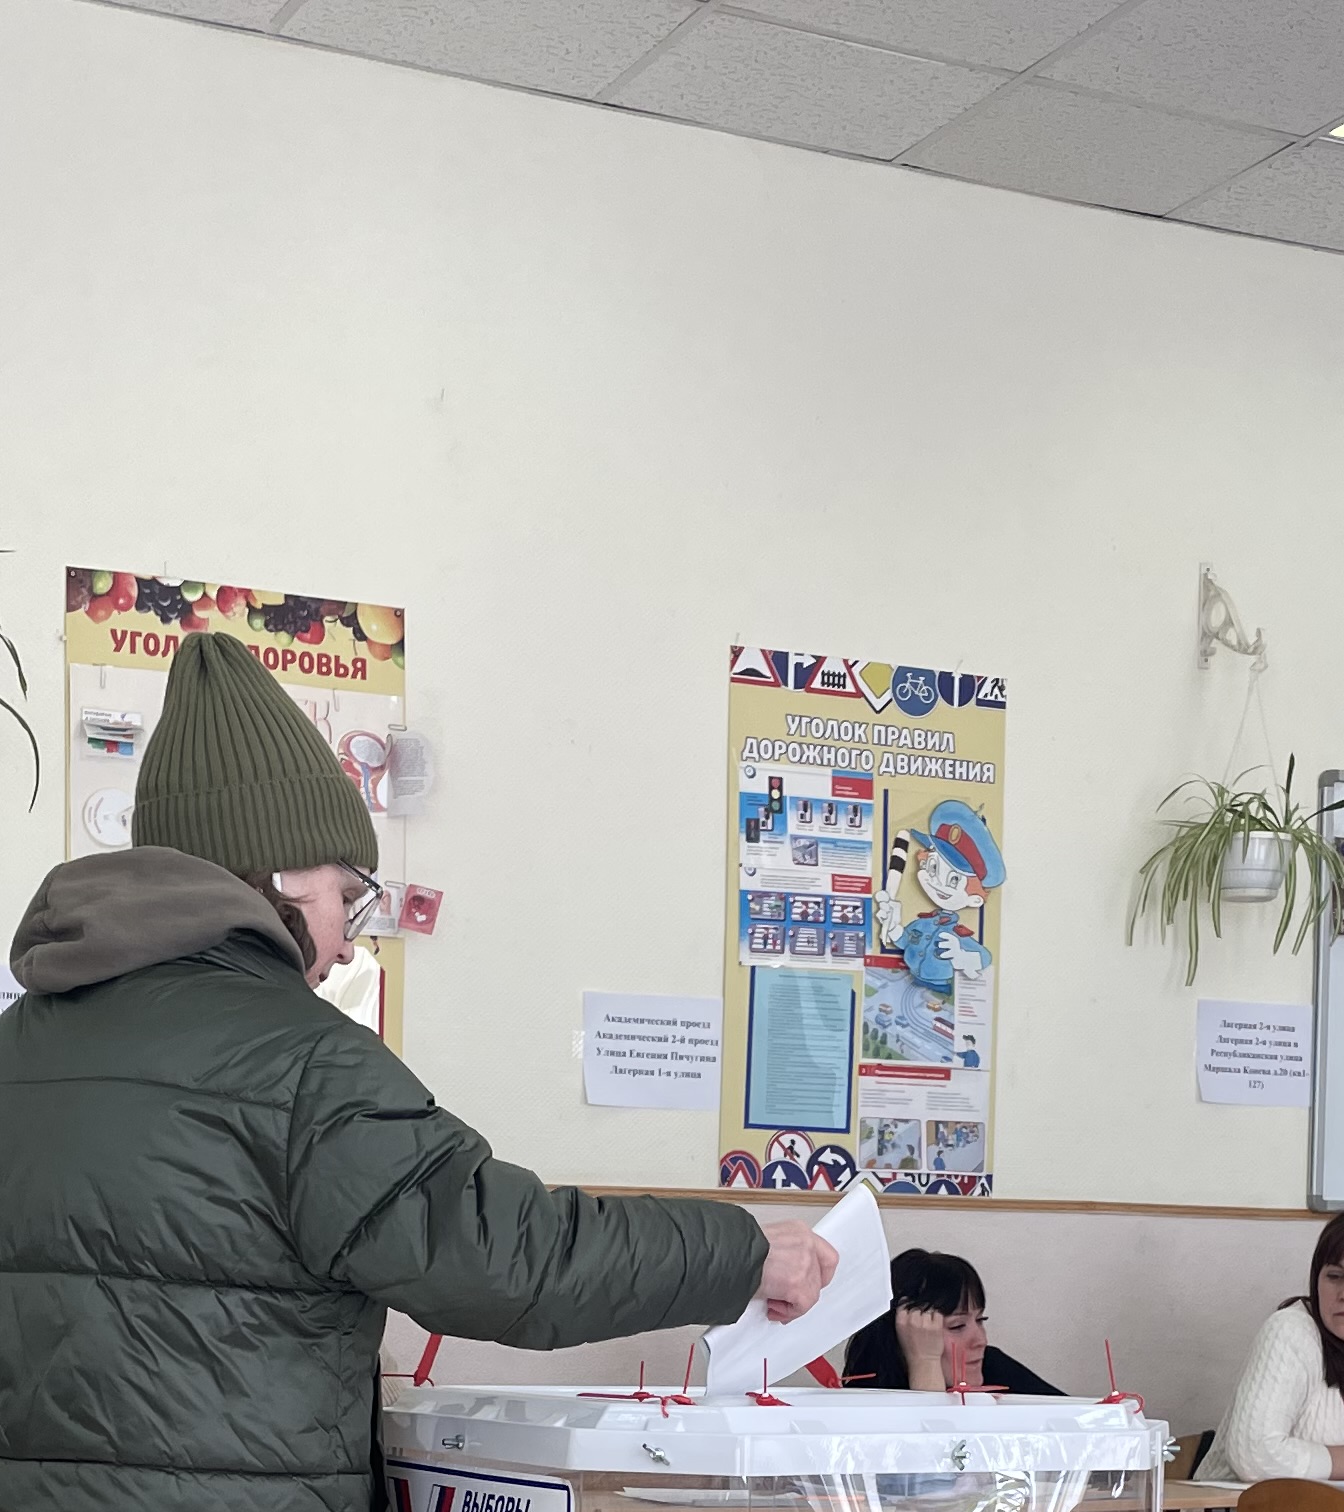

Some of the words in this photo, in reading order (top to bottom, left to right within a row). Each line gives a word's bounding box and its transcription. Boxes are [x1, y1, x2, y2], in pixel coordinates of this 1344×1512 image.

[110, 628, 179, 658] УГОЛ
[247, 644, 367, 680] ОРОВЬЯ
[786, 714, 867, 745] УГОЛОК
[872, 724, 956, 754] ПРАВИЛ
[742, 736, 875, 772] ДОРОЖНОГО
[878, 752, 996, 784] ДВИЖЕНИЯ
[604, 1014, 677, 1027] Академический
[680, 1020, 711, 1030] проезд
[595, 1030, 669, 1043] Академический
[688, 1038, 719, 1047] проезд
[596, 1046, 627, 1057] Улица
[610, 1066, 655, 1078] Лагерная
[674, 1070, 701, 1079] улица
